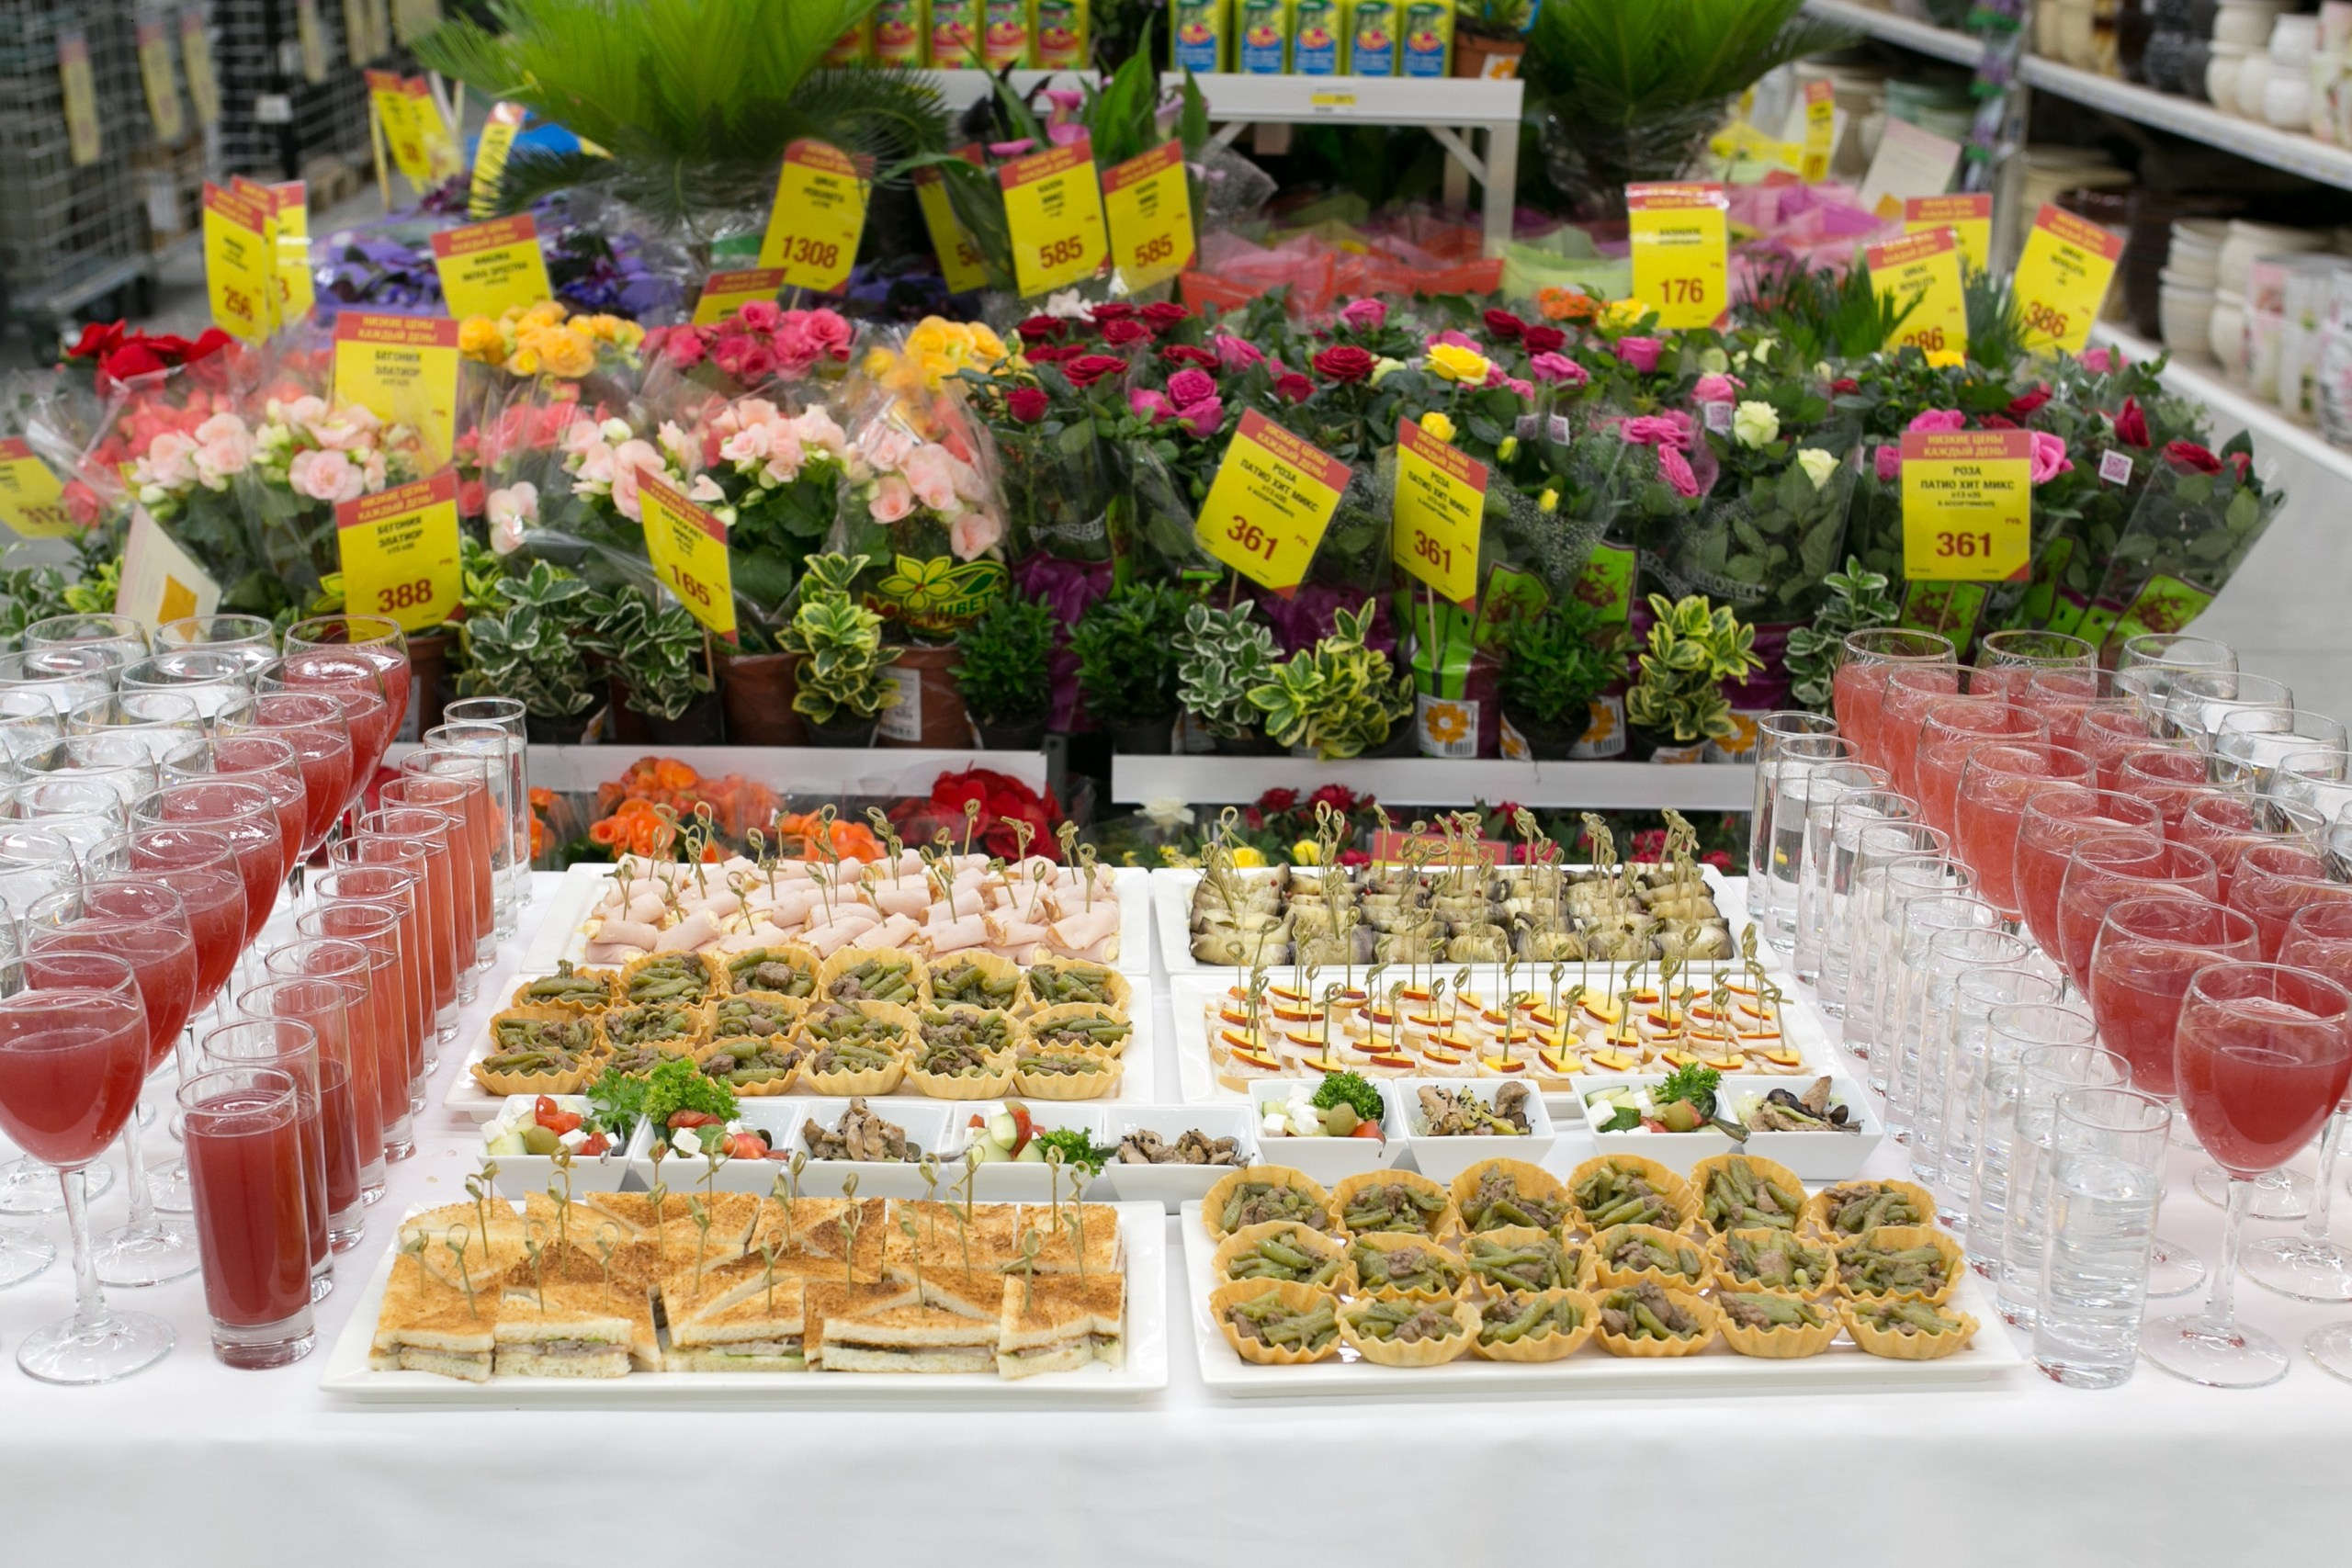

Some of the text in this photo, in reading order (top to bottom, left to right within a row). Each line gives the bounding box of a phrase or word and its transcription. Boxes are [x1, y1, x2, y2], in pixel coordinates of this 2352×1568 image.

[783, 234, 840, 269] 1308
[1039, 234, 1083, 270] 585
[1135, 233, 1173, 268] 585
[1660, 278, 1704, 304] 176
[2024, 300, 2068, 339] 386
[1924, 446, 1973, 457] КАЖДЫЙ
[1928, 434, 2004, 446] НИЗКИЕ ЦЕНЫ
[1240, 458, 1318, 513] ПАТИО ХИТ МИКС
[1272, 463, 1296, 483] РОЗА
[1431, 470, 1448, 489] РОЗА
[1921, 480, 2015, 491] ПАТИО ХИТ МИКС
[1953, 466, 1982, 476] РОЗА
[1408, 469, 1470, 518] ПАТИО ХИТ МИКС
[377, 516, 422, 535] БЕГОНИЯ
[378, 529, 424, 547] ЭЛАТИОР
[1227, 513, 1277, 561] 361
[1415, 528, 1450, 573] 361
[1936, 532, 1992, 558] 361
[378, 579, 433, 614] 388
[669, 563, 711, 607] 165
